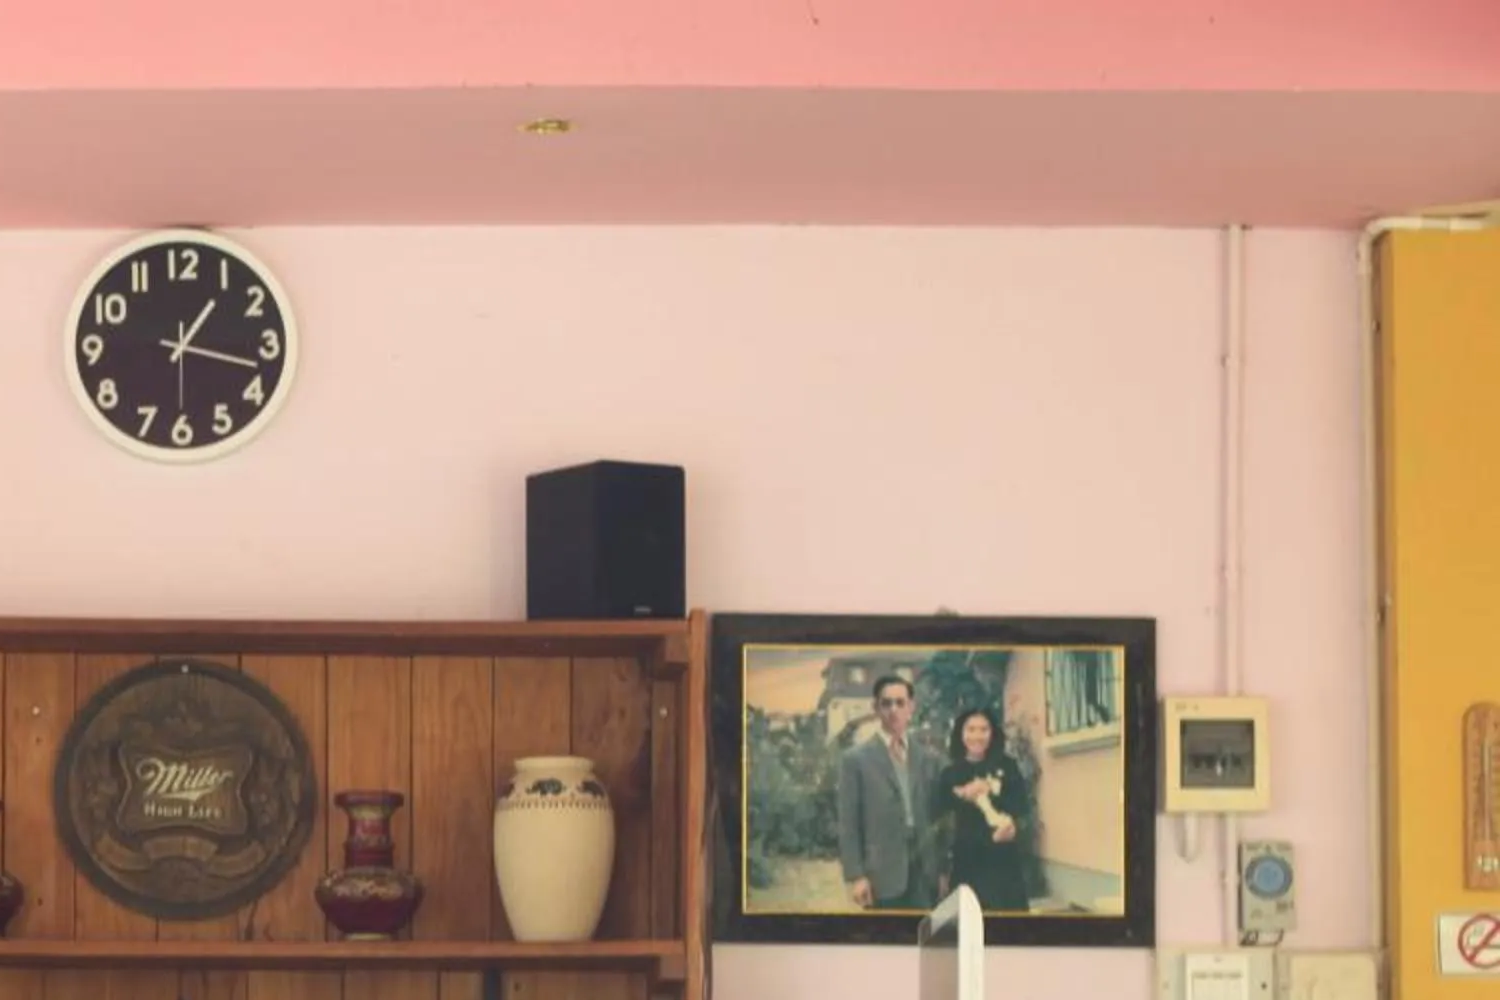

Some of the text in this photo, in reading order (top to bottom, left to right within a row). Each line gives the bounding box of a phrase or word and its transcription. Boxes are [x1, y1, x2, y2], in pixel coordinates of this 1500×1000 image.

[131, 261, 148, 292] 11
[167, 249, 199, 280] 12
[220, 258, 229, 291] 1
[95, 294, 127, 325] 10
[244, 285, 265, 317] 2
[81, 334, 104, 366] 9
[258, 329, 280, 360] 3
[97, 378, 119, 409] 8
[242, 375, 264, 406] 4
[137, 406, 158, 438] 7
[171, 414, 194, 446] 6
[212, 403, 233, 434] 5
[136, 758, 233, 797] Miller
